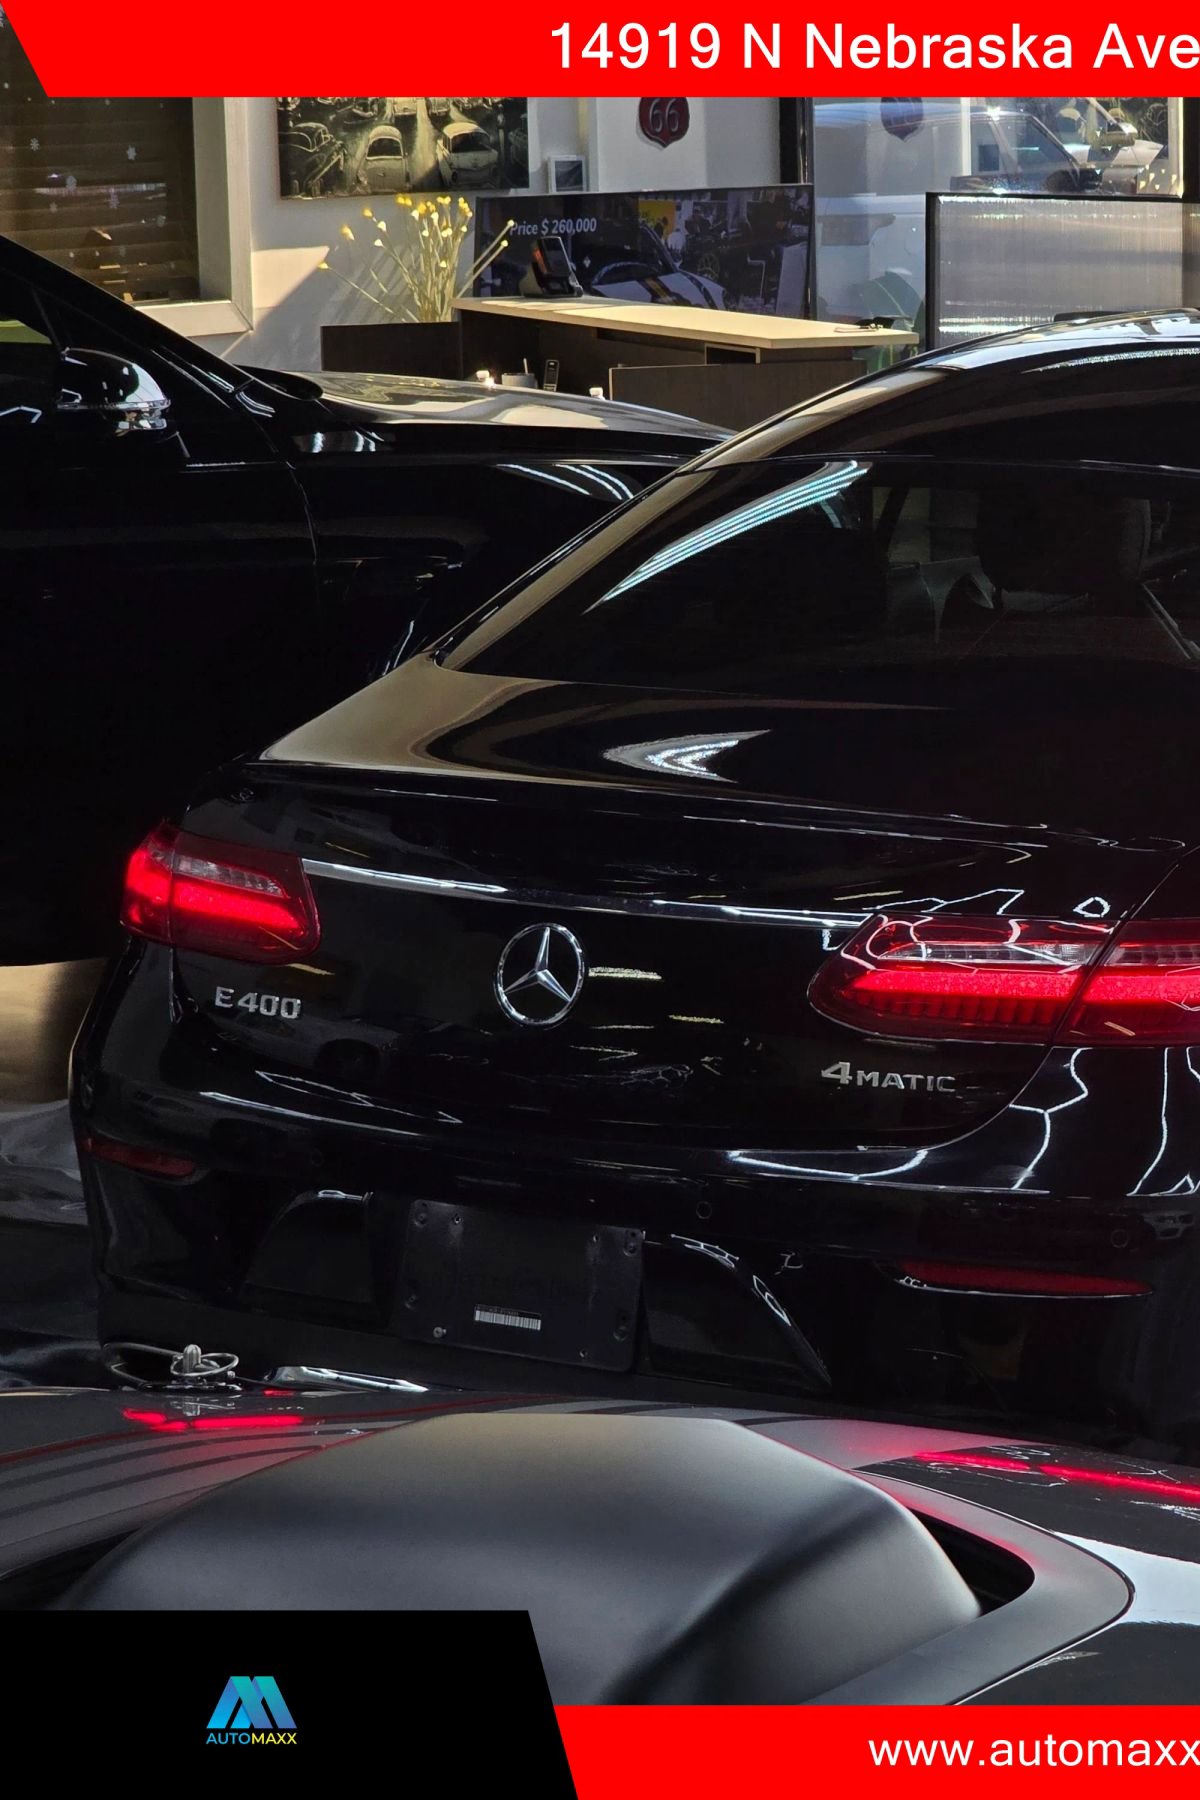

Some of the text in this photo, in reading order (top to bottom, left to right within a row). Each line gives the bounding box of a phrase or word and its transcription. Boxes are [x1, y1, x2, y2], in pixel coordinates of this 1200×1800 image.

[649, 97, 679, 132] 66
[509, 220, 539, 236] Price
[552, 218, 597, 235] 260,000
[820, 1061, 956, 1092] 4MATIC
